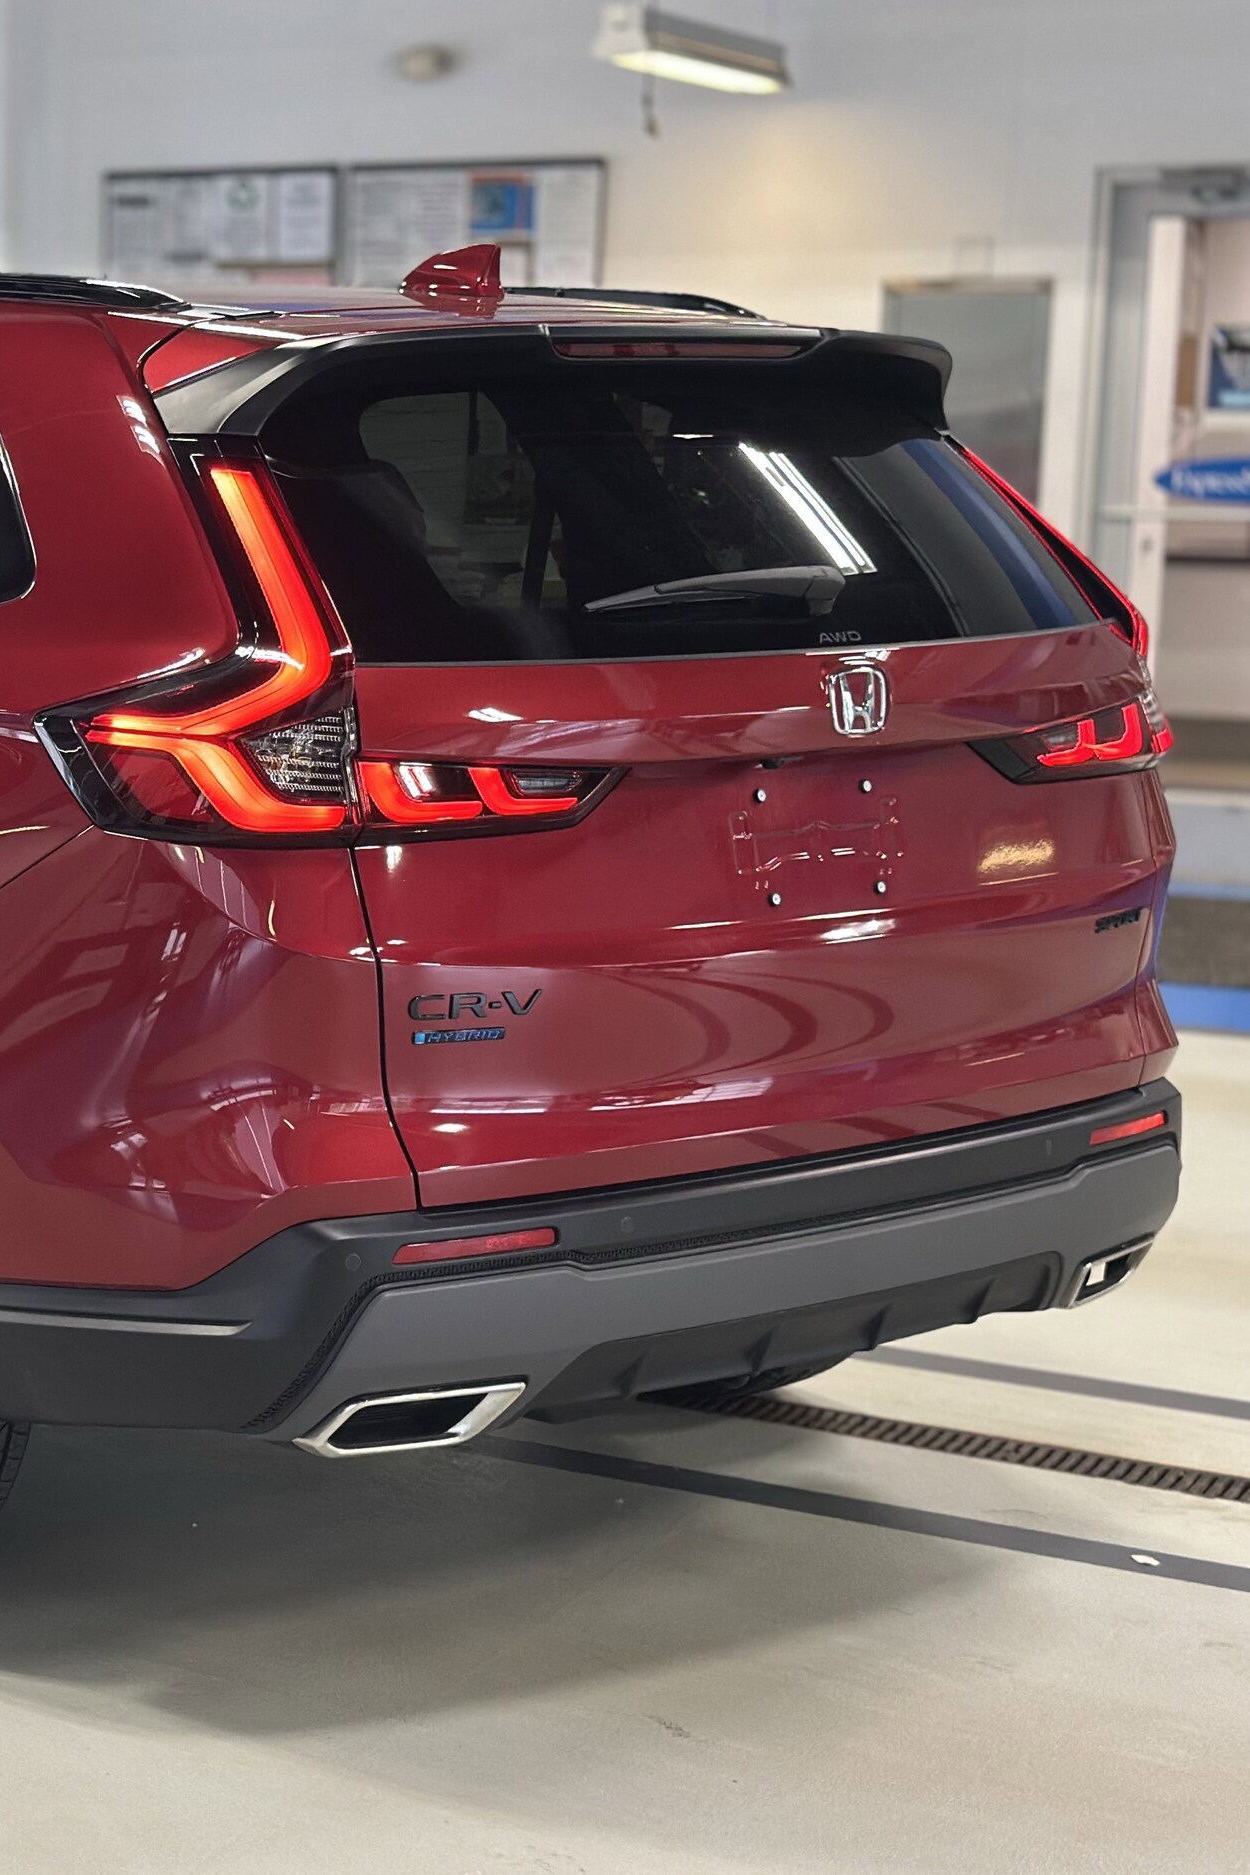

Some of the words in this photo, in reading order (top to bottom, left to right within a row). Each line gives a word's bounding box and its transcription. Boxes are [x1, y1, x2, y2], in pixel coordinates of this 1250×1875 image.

[819, 630, 862, 644] AWD
[408, 988, 543, 1021] CR-V
[427, 1028, 501, 1043] HYBRID
